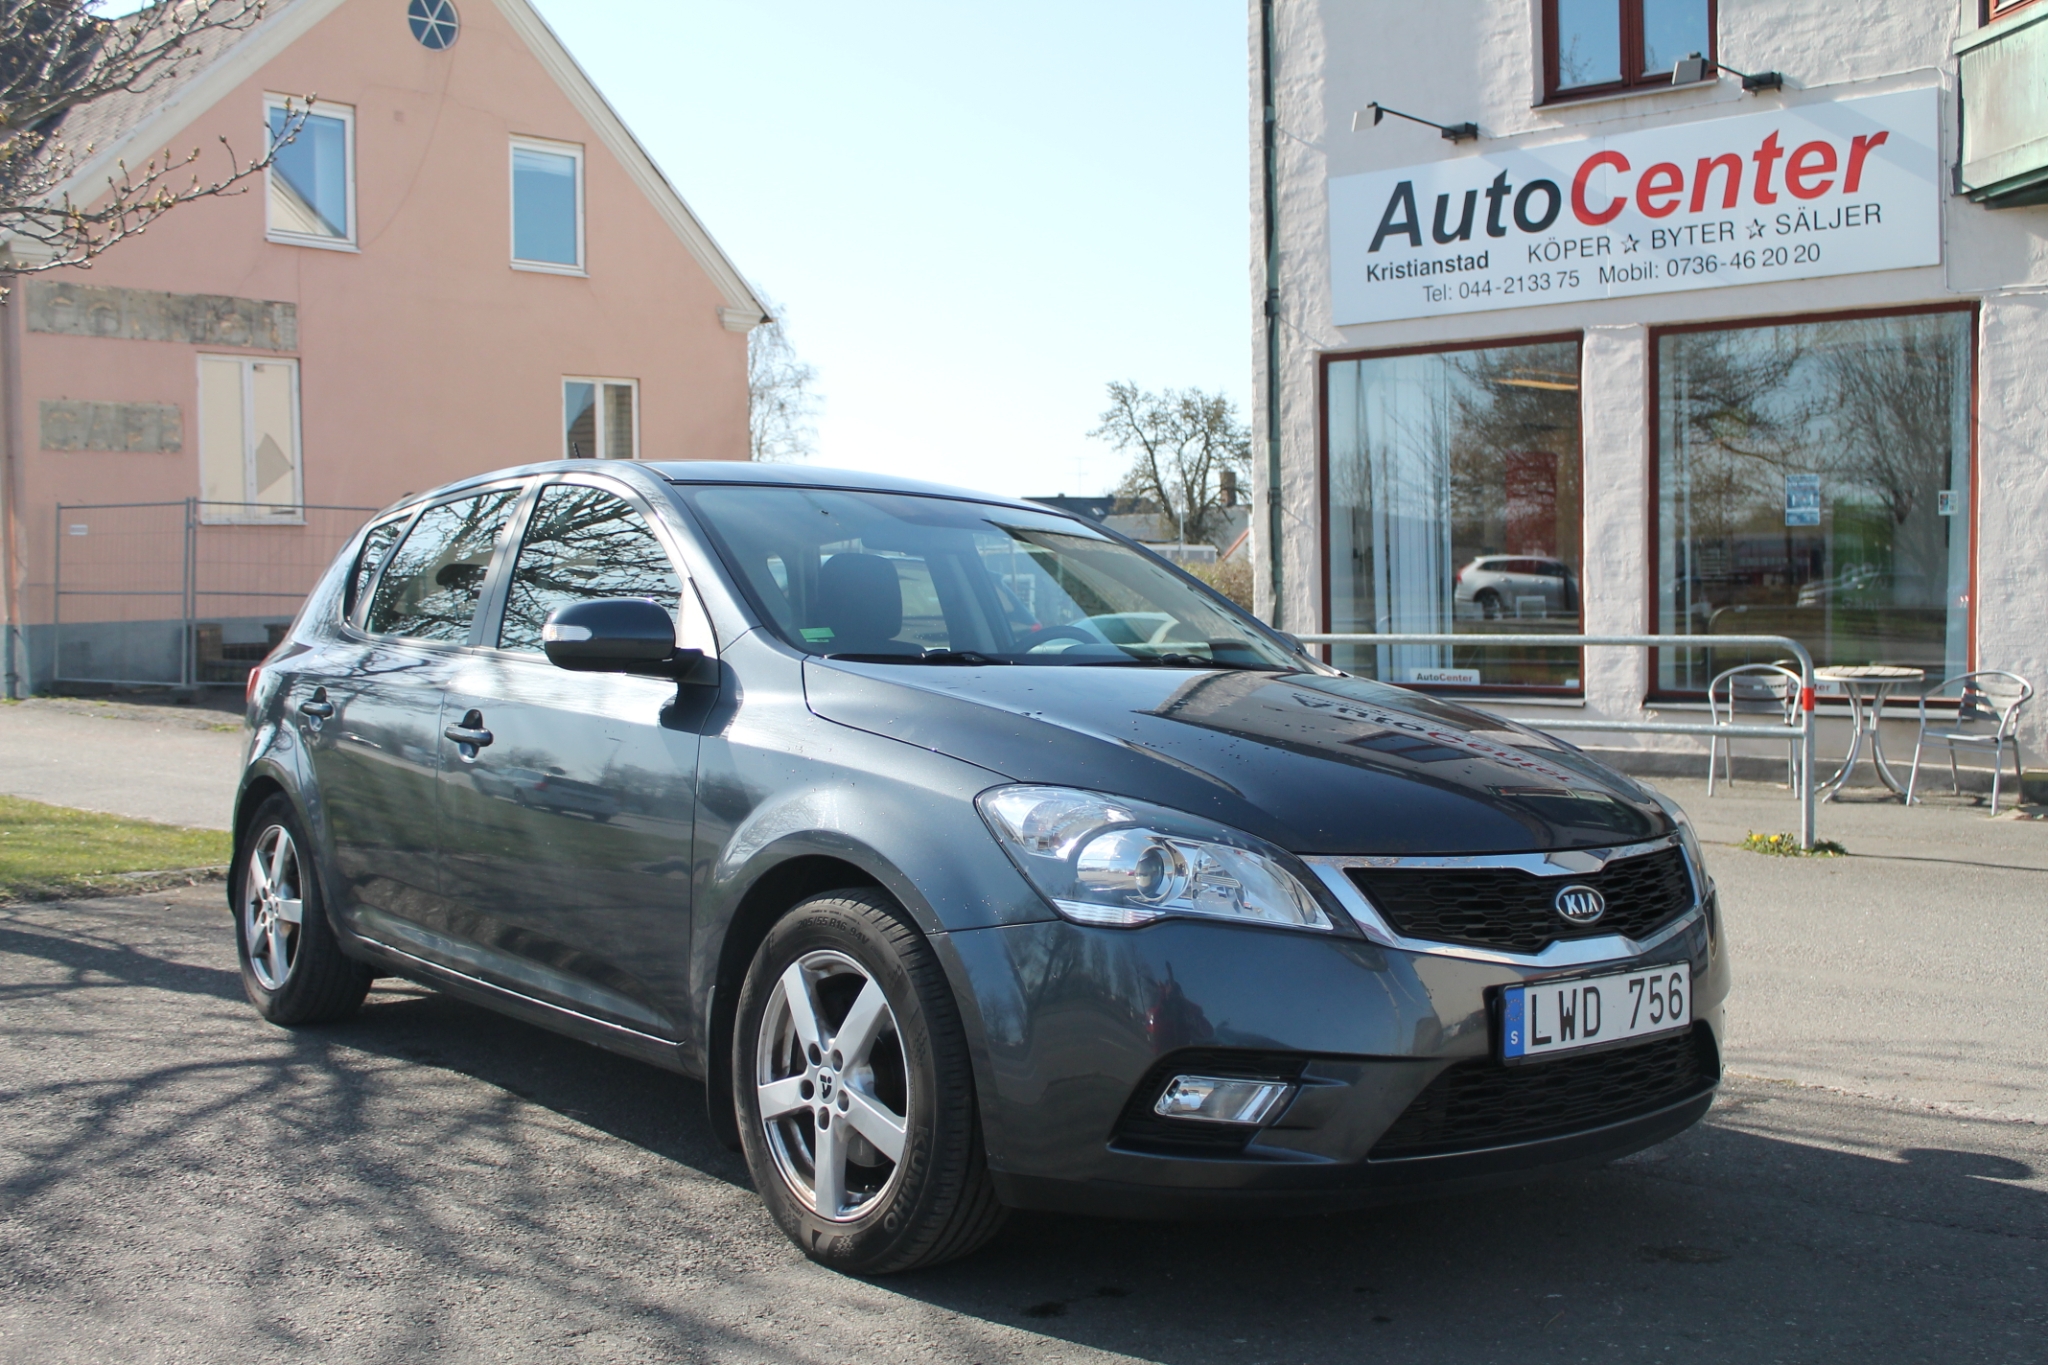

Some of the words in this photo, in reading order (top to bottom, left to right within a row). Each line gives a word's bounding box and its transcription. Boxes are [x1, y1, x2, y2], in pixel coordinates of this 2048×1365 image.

[1367, 129, 1890, 253] AutoCenter
[1528, 236, 1611, 263] KÖPER
[1652, 221, 1735, 249] BYTER
[1776, 203, 1881, 235] SÄLJER
[1367, 250, 1489, 282] Kristianstad
[1423, 284, 1452, 302] Tel:
[1599, 261, 1659, 284] Mobil:
[1417, 673, 1473, 682] AutoCenter
[1563, 893, 1600, 915] KIA
[1531, 985, 1601, 1046] LWD
[1628, 972, 1683, 1029] 756
[1510, 1030, 1519, 1045] S
[884, 1125, 929, 1233] KUMHO
